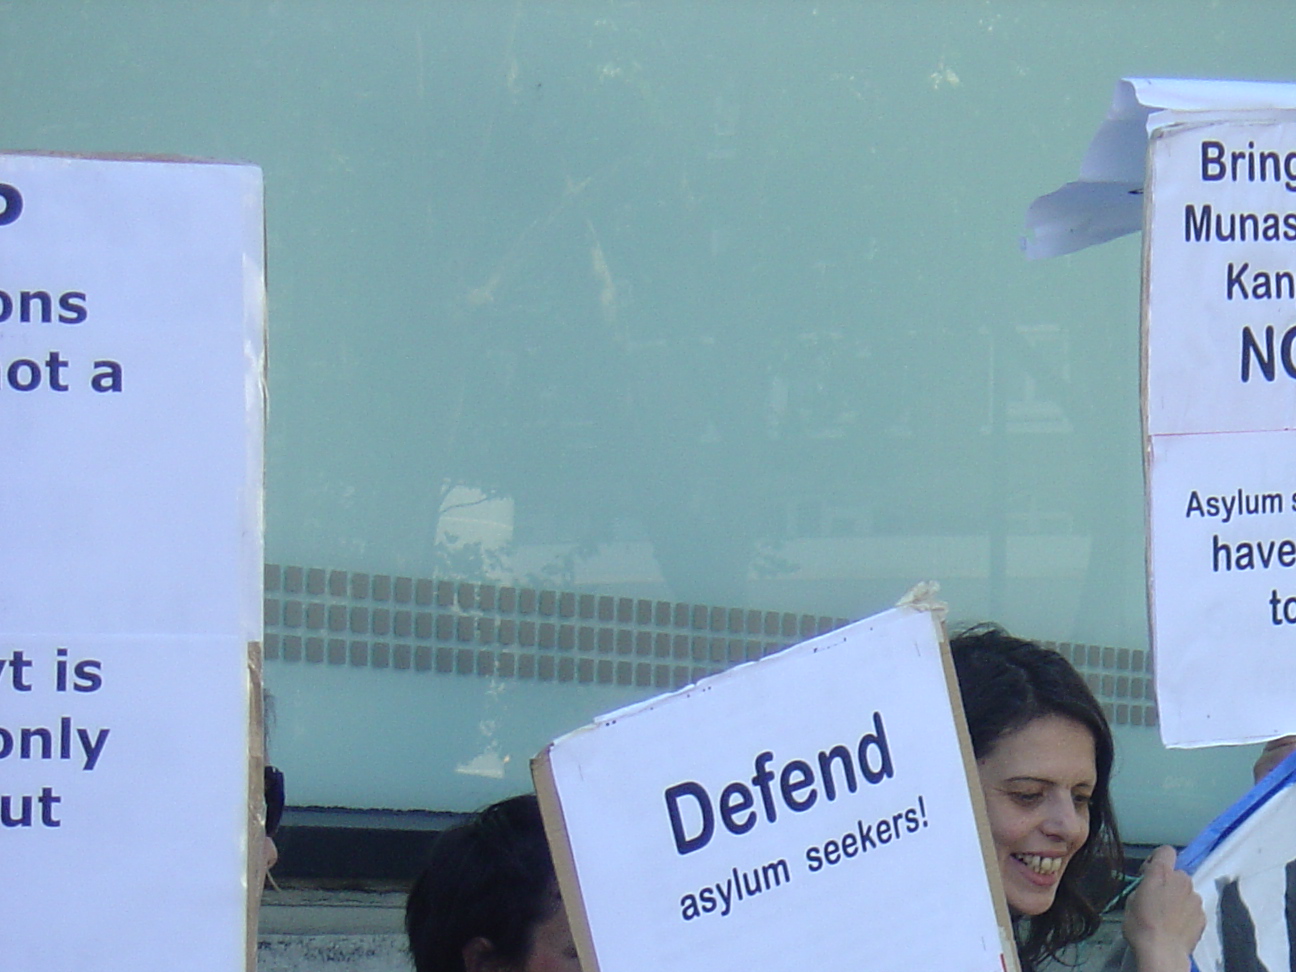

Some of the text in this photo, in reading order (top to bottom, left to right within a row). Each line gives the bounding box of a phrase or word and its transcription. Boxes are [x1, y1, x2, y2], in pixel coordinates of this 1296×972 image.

[0, 351, 123, 393] ot a
[1185, 490, 1283, 524] Asylum
[1212, 534, 1296, 573] have
[56, 648, 102, 693] is
[664, 711, 894, 856] Defend
[680, 794, 929, 921] asylum seekers!
